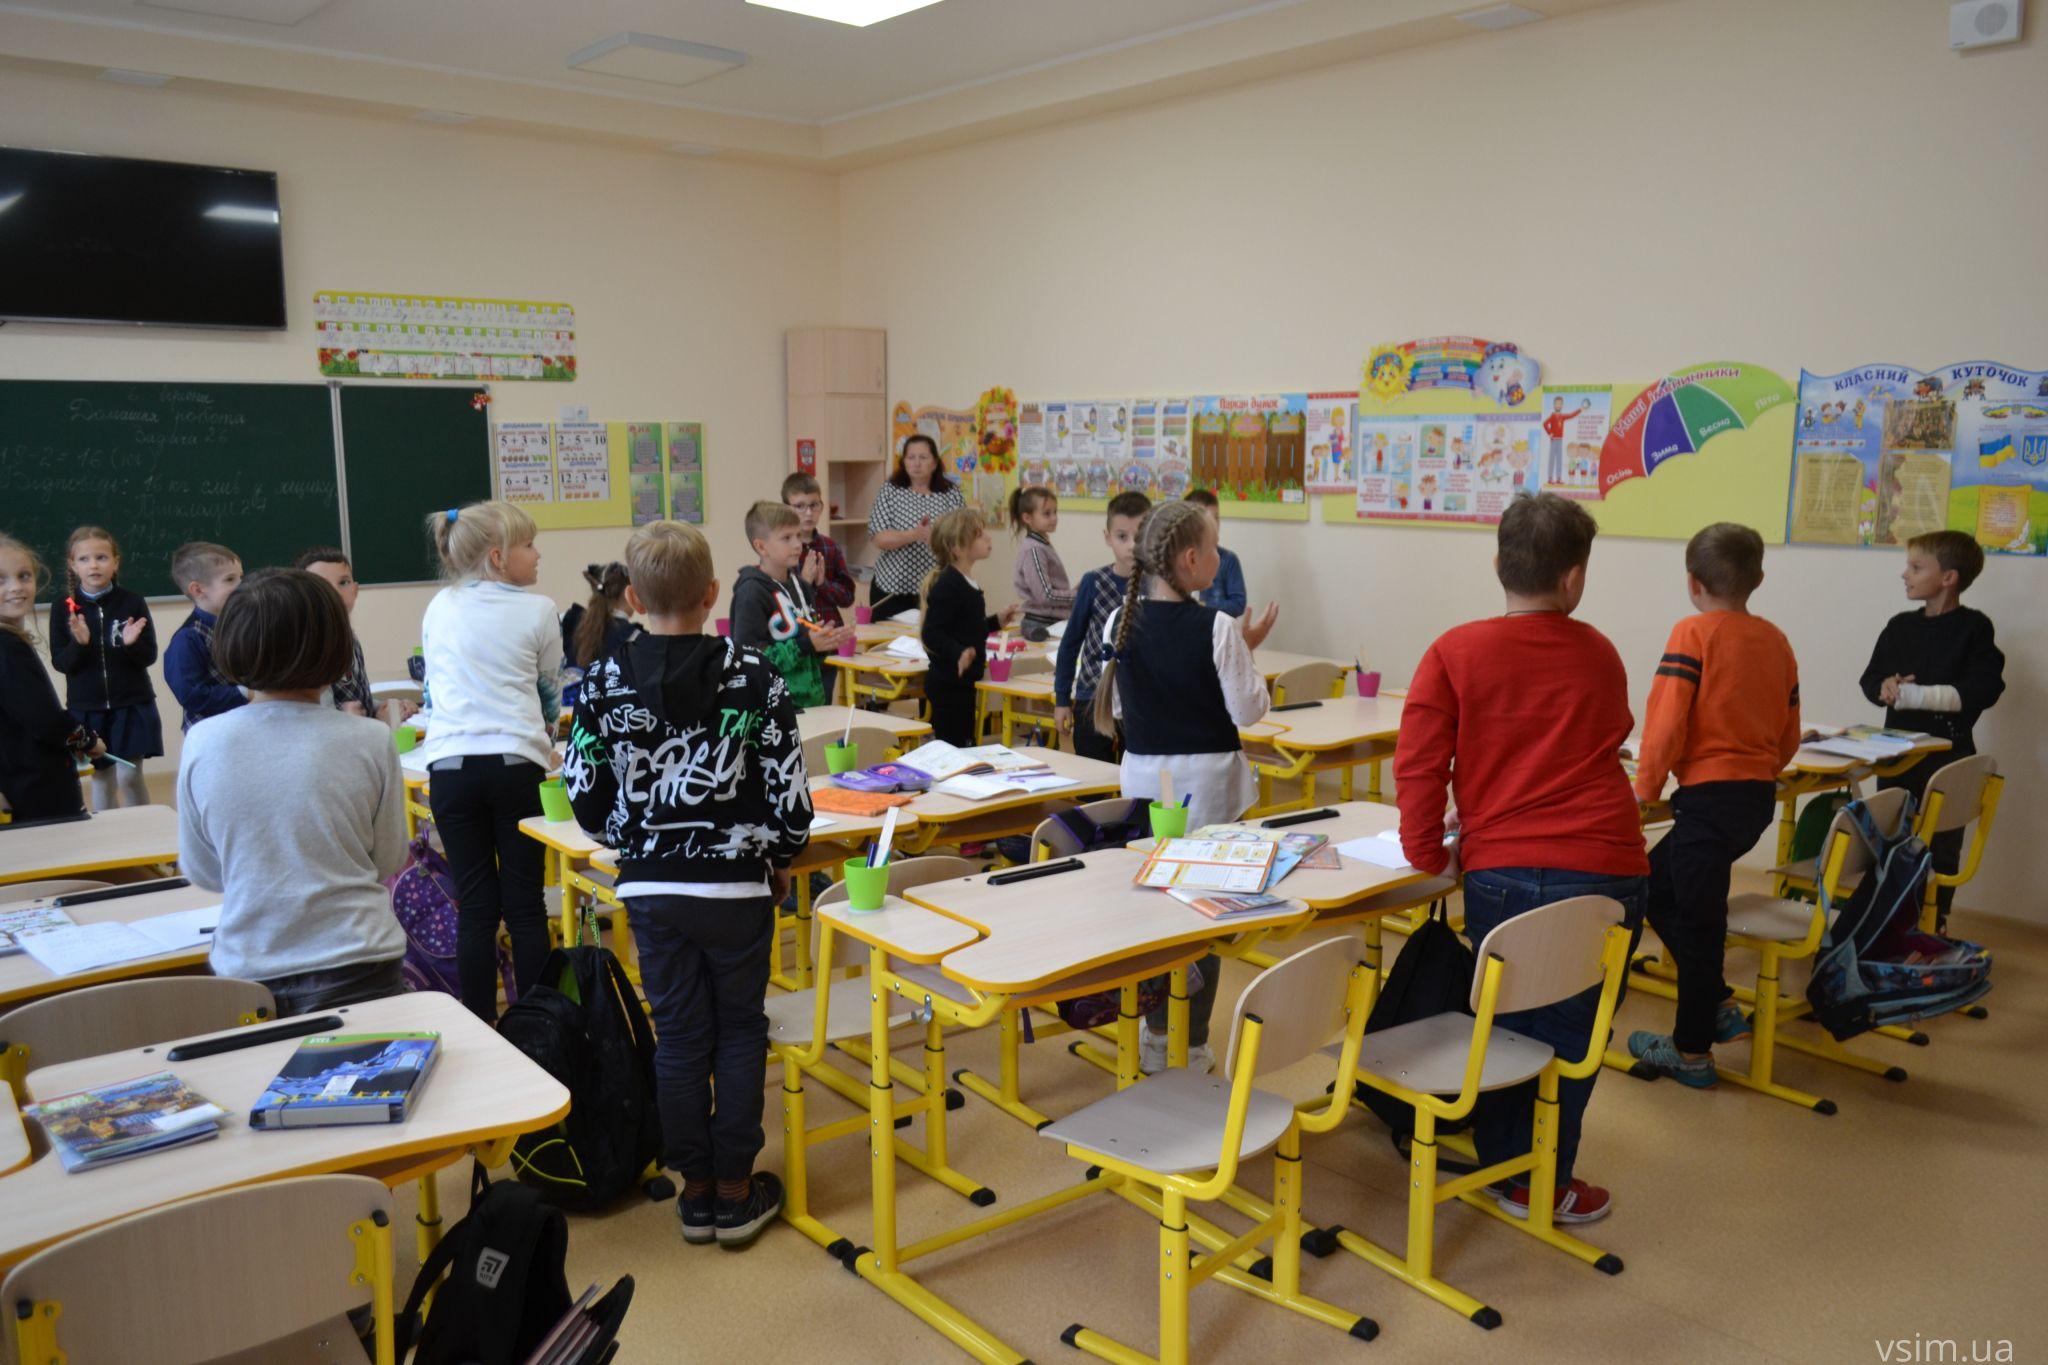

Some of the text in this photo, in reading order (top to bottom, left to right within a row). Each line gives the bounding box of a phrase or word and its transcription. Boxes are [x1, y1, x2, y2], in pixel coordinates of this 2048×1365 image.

[1834, 366, 2029, 391] КЛАСНИЙ КУТОЧОК
[1219, 398, 1249, 410] Паркан
[1613, 398, 1647, 437] Наші
[1699, 417, 1731, 437] Весна
[501, 436, 508, 446] 5
[522, 435, 528, 446] 3
[541, 435, 548, 445] 8
[559, 435, 564, 445] 2
[575, 435, 581, 446] 5
[595, 435, 607, 445] 10
[1652, 444, 1679, 462] Зима
[506, 477, 512, 486] 6
[523, 475, 529, 485] 4
[543, 475, 549, 485] 2
[561, 473, 572, 483] 12
[582, 473, 588, 482] 3
[600, 473, 607, 482] 4
[1606, 468, 1633, 485] Осінь
